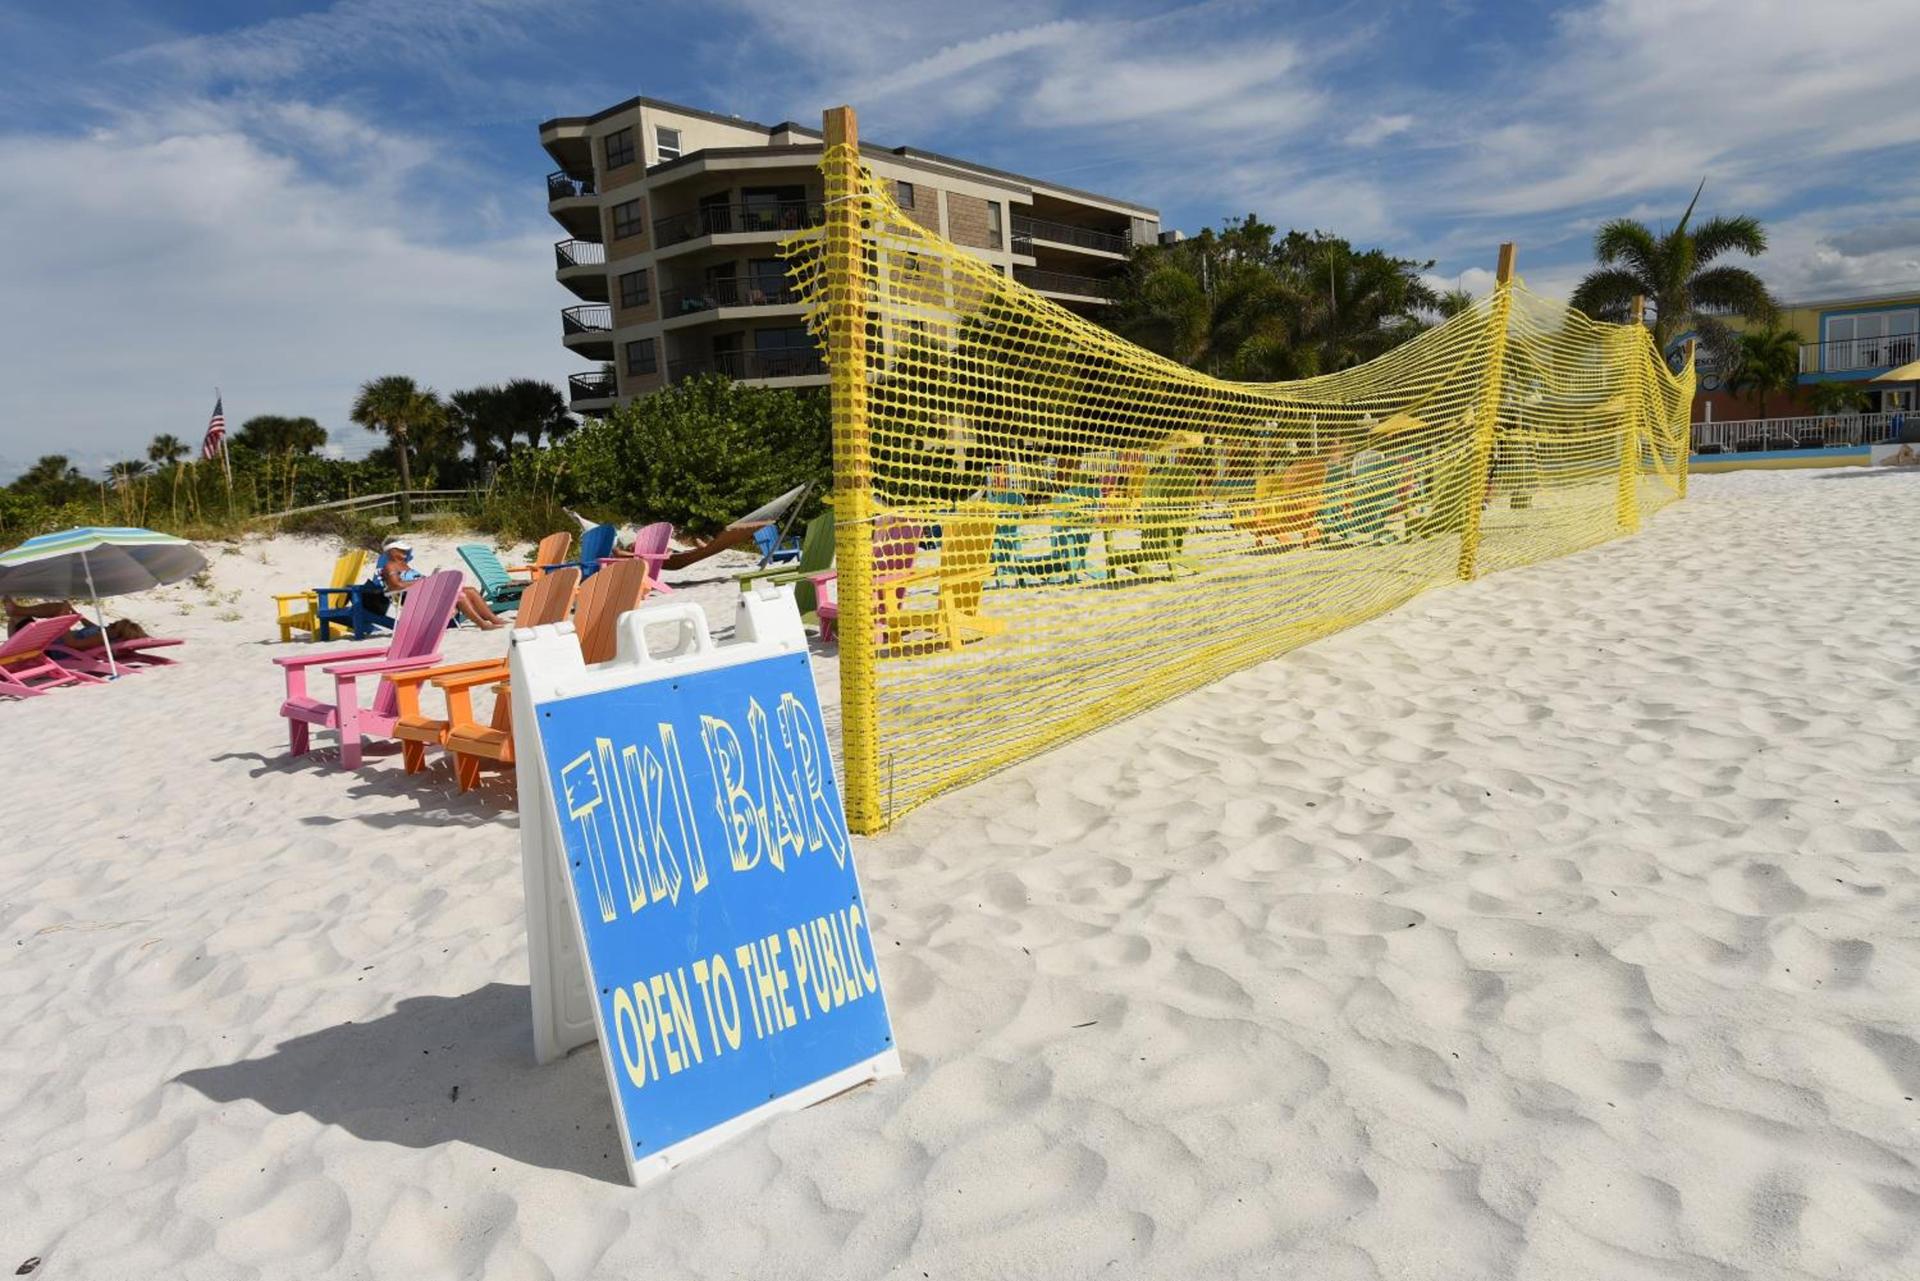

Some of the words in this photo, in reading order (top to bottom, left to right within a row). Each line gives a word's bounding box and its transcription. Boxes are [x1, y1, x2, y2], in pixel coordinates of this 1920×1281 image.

[561, 722, 709, 923] TIKI
[700, 692, 846, 872] BAR
[613, 967, 703, 1088] OPEN
[692, 954, 742, 1057] TO
[735, 934, 797, 1039] THE
[787, 904, 877, 1020] PUBLIC
